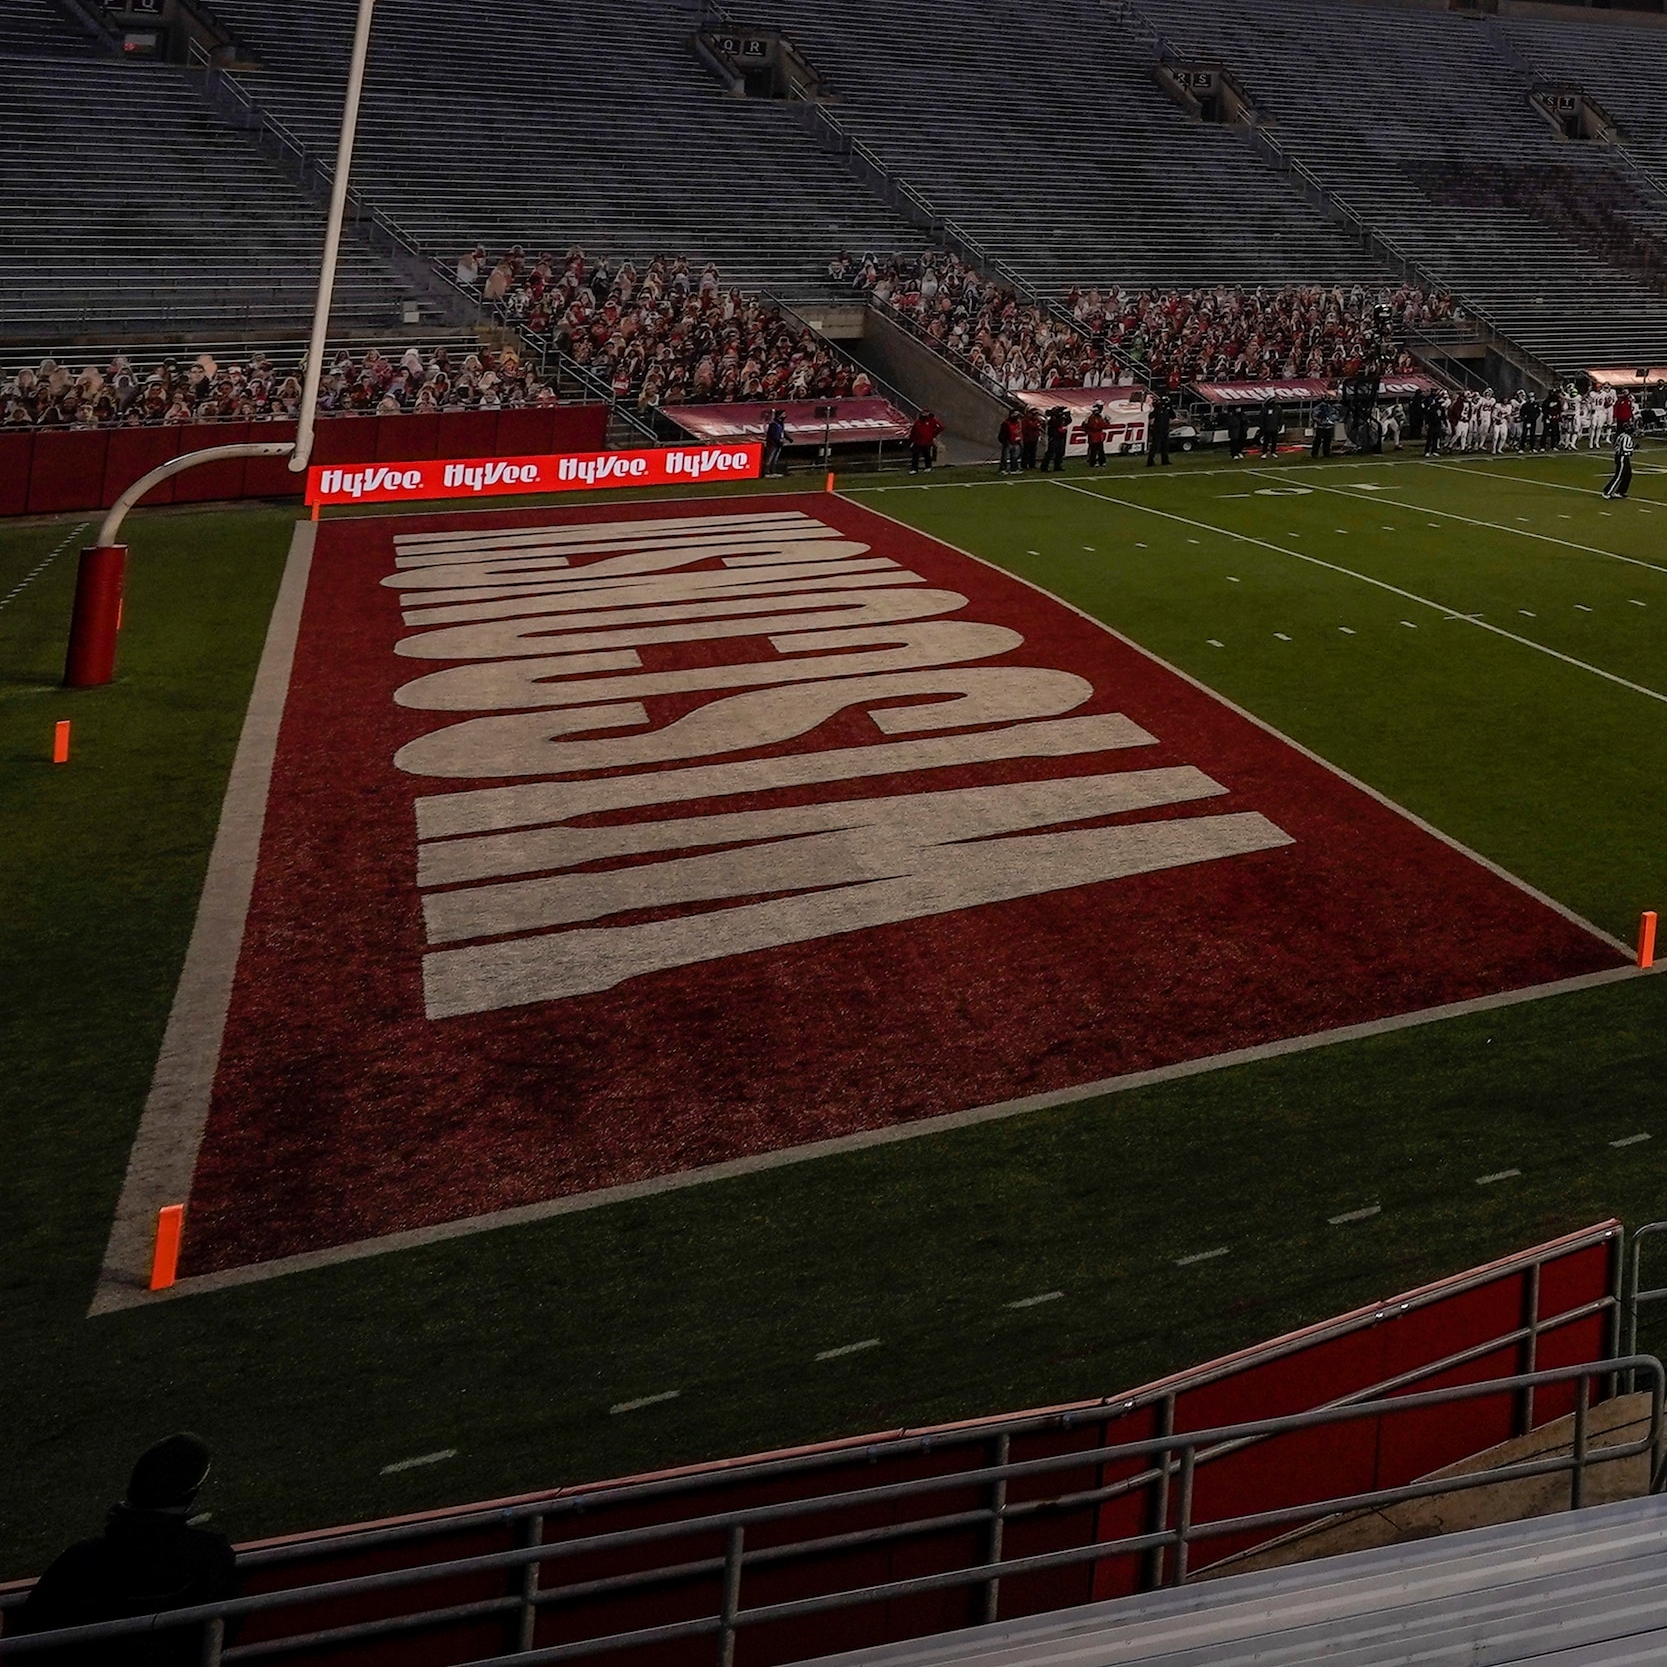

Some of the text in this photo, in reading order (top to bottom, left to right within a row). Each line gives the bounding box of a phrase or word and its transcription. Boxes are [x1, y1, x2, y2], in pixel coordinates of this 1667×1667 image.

[749, 40, 761, 54] R
[1069, 422, 1145, 445] EPN
[443, 462, 541, 491] HyVee
[558, 455, 649, 485] HyVee
[665, 449, 750, 478] HyVee
[320, 467, 424, 498] HyVee
[378, 509, 1296, 1020] WISCONSIN
